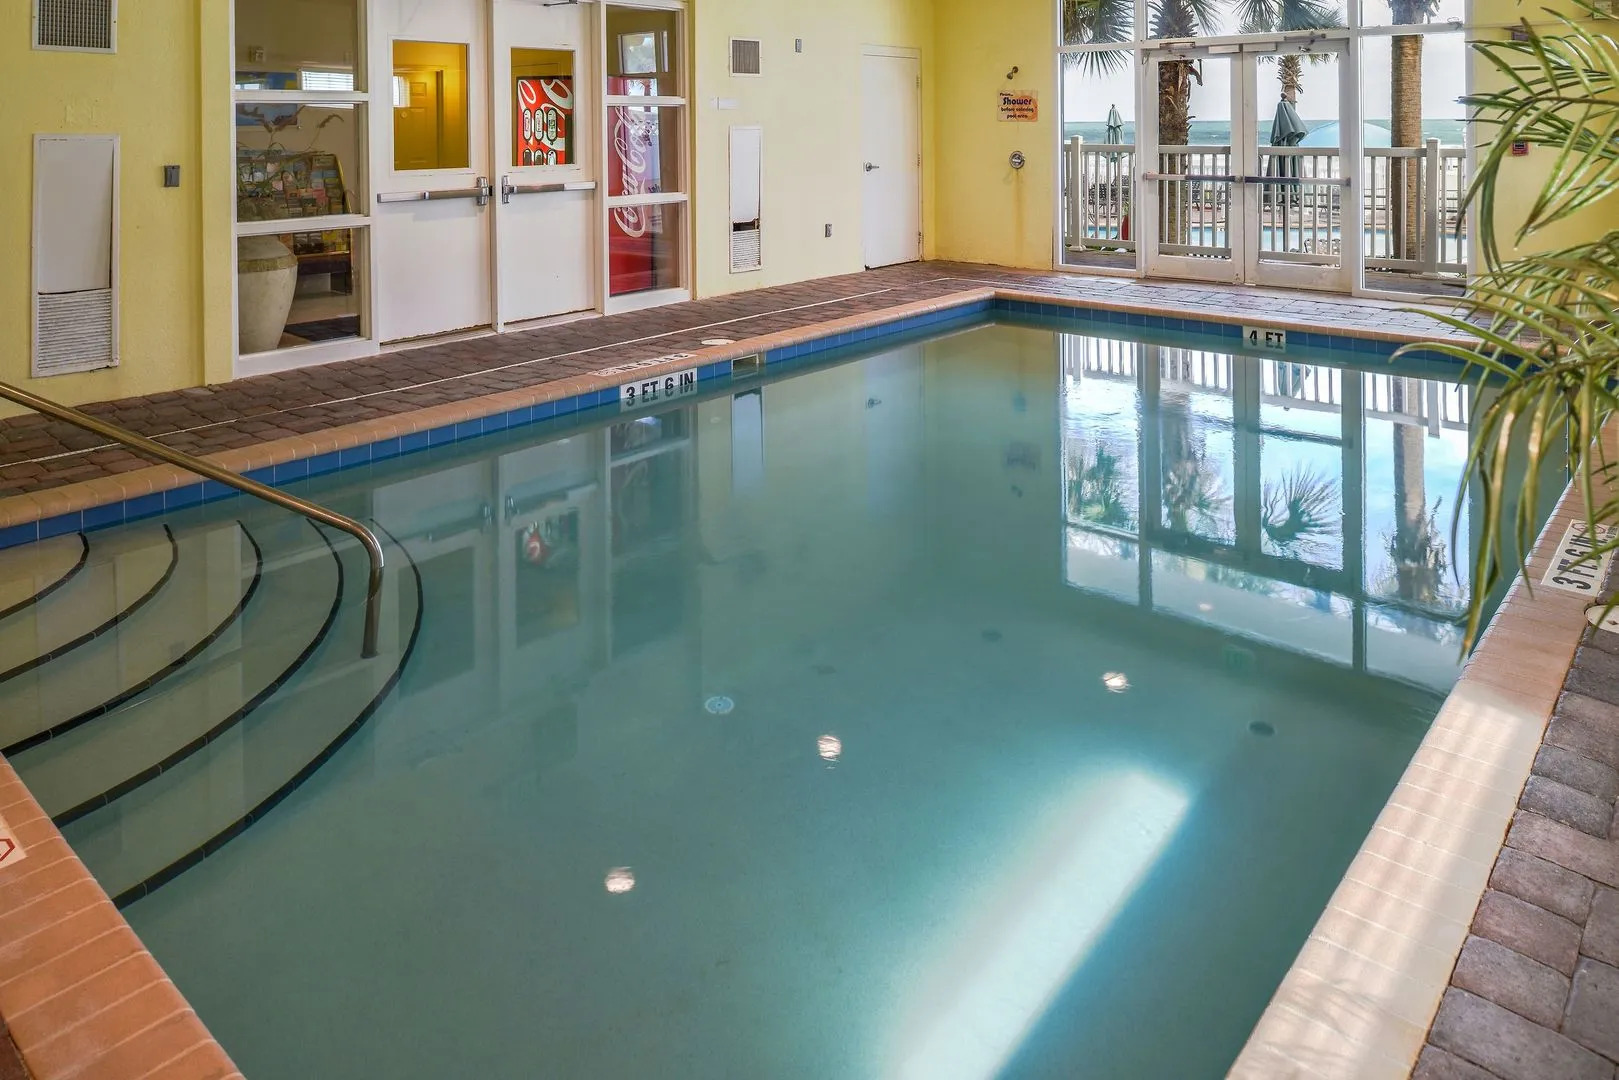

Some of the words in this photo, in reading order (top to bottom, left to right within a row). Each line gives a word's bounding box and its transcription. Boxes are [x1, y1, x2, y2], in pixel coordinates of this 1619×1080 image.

[1003, 97, 1032, 105] Shower
[1249, 330, 1257, 339] 4
[1265, 332, 1283, 342] FT
[626, 386, 636, 399] 3
[641, 380, 659, 396] FT
[664, 377, 674, 389] 6
[679, 371, 694, 386] IN
[1552, 576, 1591, 589] 3
